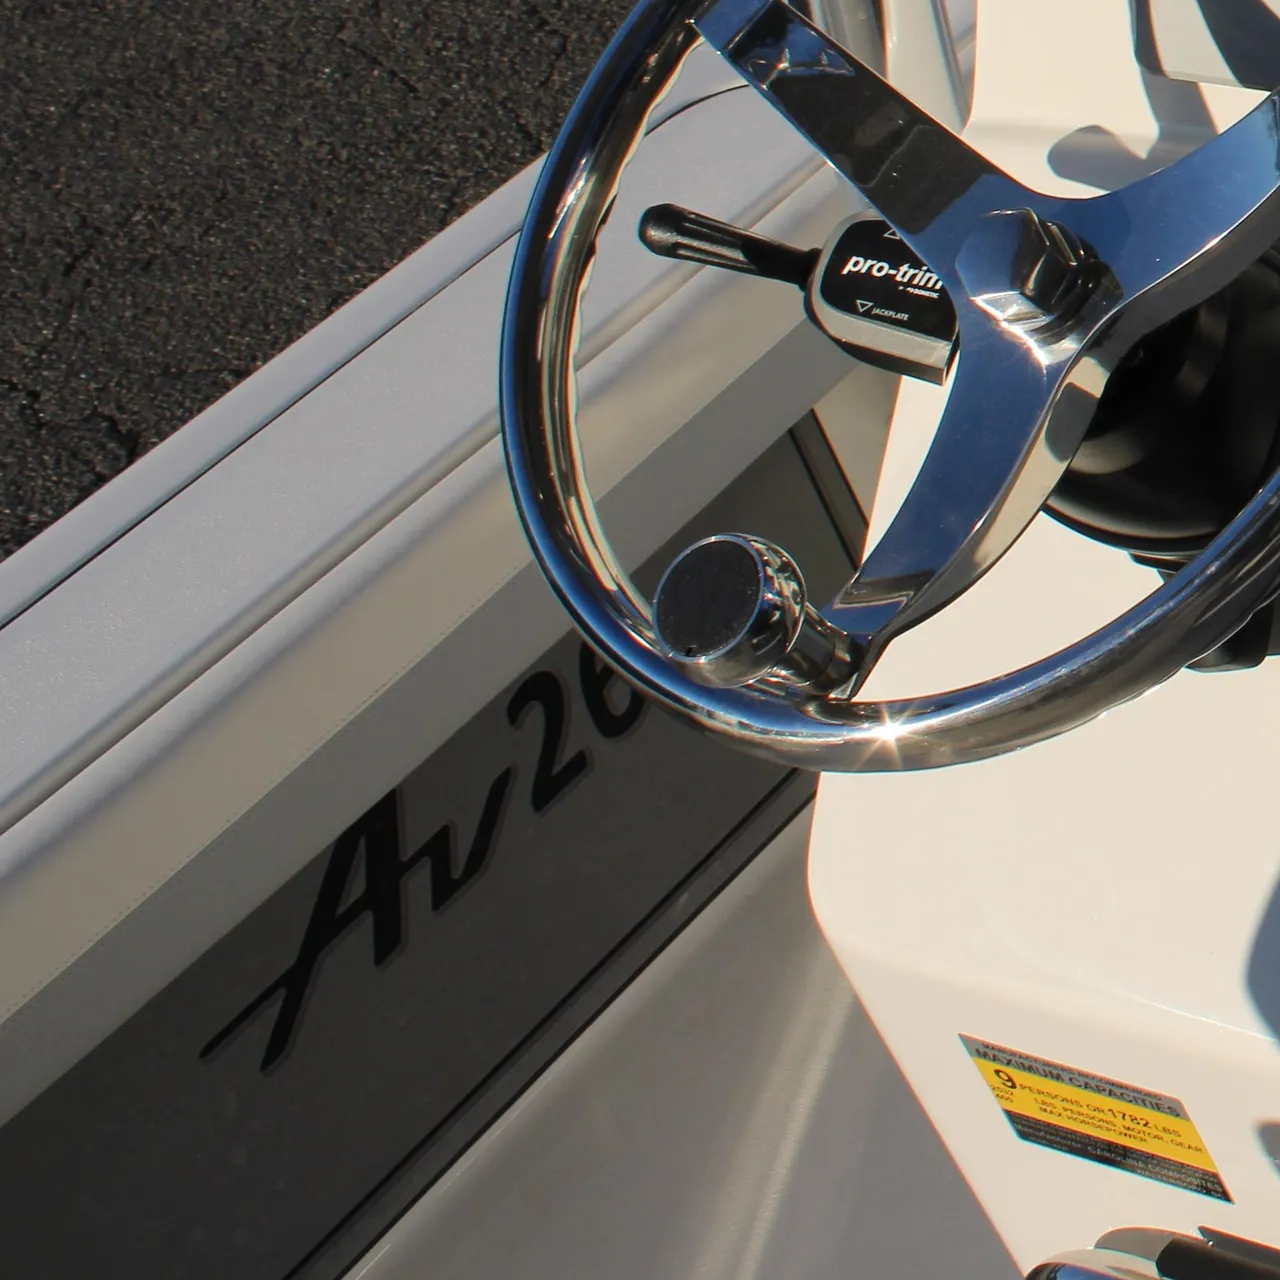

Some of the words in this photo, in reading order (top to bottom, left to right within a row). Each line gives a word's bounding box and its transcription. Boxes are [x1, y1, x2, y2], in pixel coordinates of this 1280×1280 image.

[841, 255, 944, 290] pro-trim
[975, 1047, 1066, 1082] MAXIMUM
[1068, 1076, 1182, 1118] CAPACITIES
[994, 1068, 1017, 1089] 9
[1018, 1082, 1083, 1108] PERSONS
[1107, 1107, 1151, 1128] 1782
